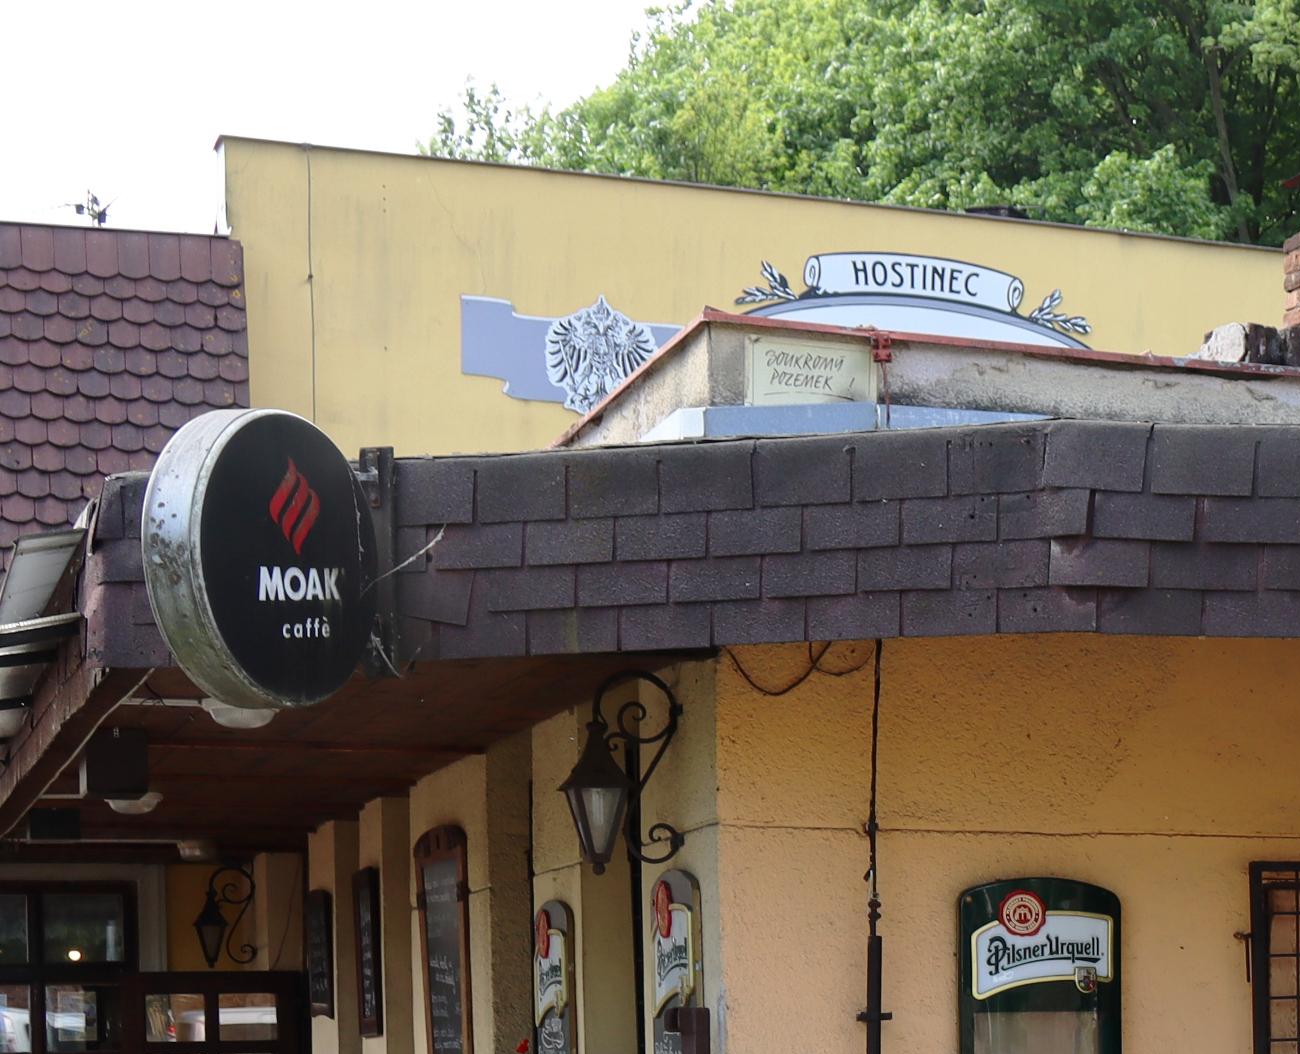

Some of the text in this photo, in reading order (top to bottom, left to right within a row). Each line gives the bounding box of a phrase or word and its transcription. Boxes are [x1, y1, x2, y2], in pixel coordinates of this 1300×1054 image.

[852, 260, 980, 297] HOSTINEC
[770, 368, 833, 391] POZEMEK
[259, 566, 342, 602] MOAK
[282, 616, 330, 639] caffè
[986, 933, 1101, 976] Pilsner Urquell
